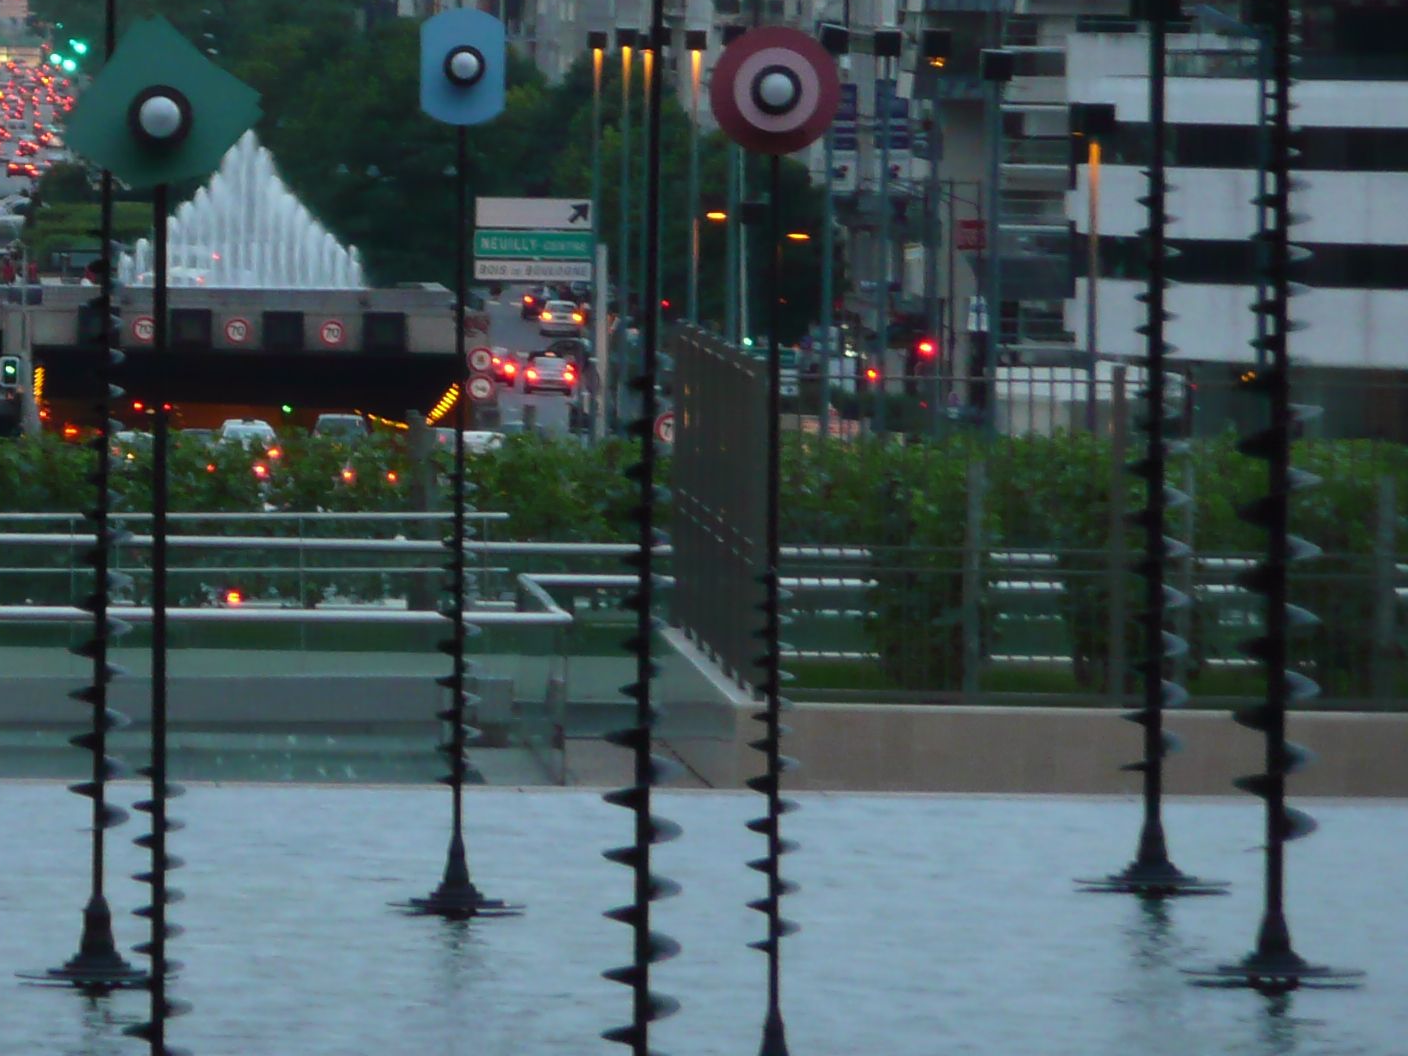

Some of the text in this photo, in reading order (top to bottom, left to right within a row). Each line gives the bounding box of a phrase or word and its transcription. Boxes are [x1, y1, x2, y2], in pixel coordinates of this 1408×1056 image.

[480, 237, 537, 251] NEUILLY
[230, 326, 245, 337] 70
[325, 327, 340, 339] 70
